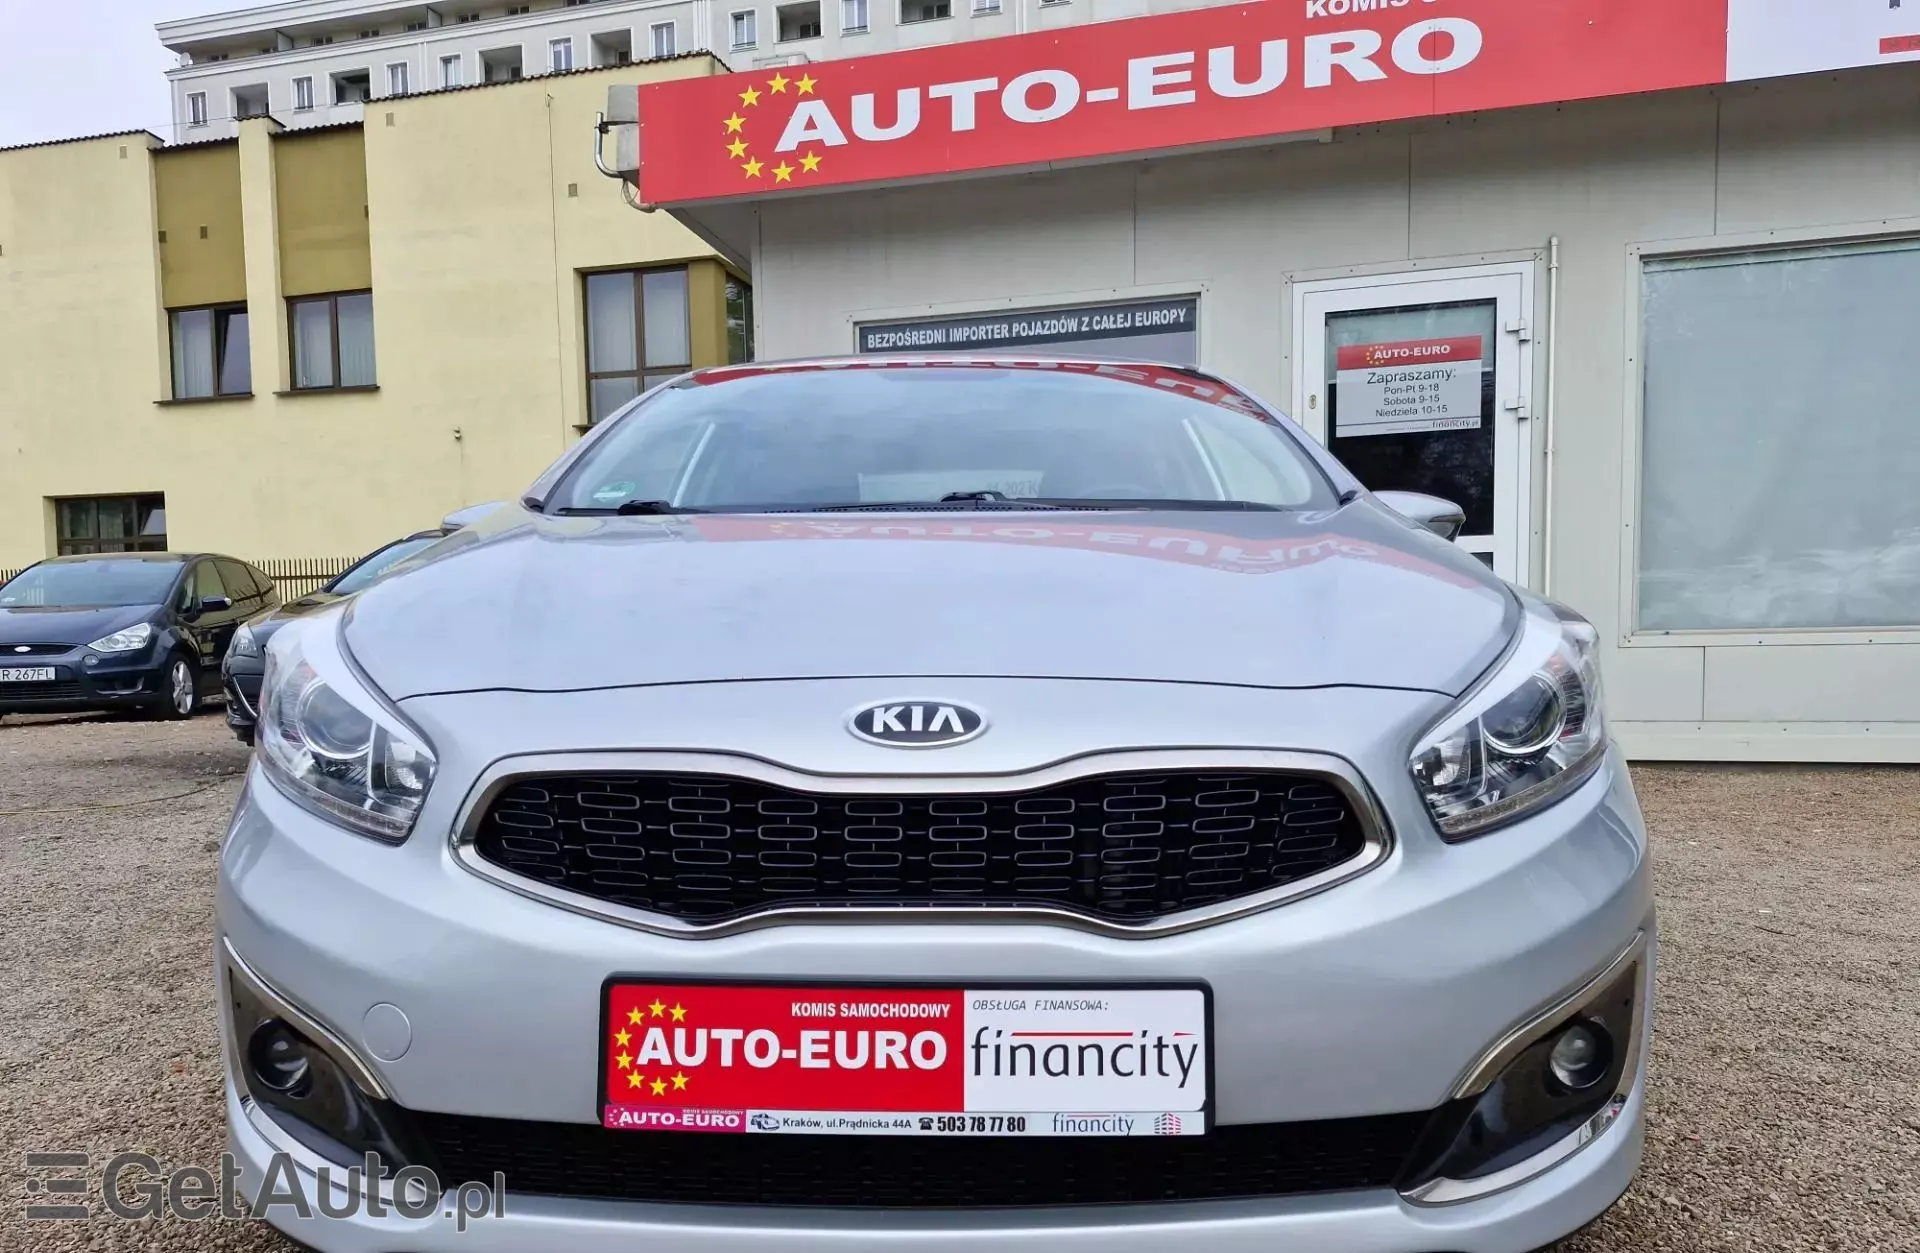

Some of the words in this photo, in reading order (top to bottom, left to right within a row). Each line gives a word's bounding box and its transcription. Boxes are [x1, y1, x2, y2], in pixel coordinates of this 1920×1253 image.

[775, 16, 1483, 153] AUTO-EURO
[867, 328, 946, 349] BEZPOŚREDNI
[950, 324, 1010, 342] IMPORTER
[1012, 315, 1078, 337] POJAZDÓW
[1081, 317, 1089, 331] Z
[1092, 312, 1131, 330] CAŁEJ
[1135, 308, 1187, 327] EUROPY
[1374, 344, 1451, 360] AUTO-EURO
[1367, 368, 1457, 385] Zapraszamy:
[1383, 386, 1416, 395] Pon-Pt
[1418, 383, 1440, 393] 9-18
[1383, 396, 1416, 406] Sobota
[1418, 395, 1440, 404] 9-15
[1376, 407, 1418, 417] Niedziela
[1421, 404, 1448, 415] 10-15
[15, 669, 53, 680] 267FL
[872, 705, 965, 733] KIA
[791, 1002, 836, 1017] KOMIS
[840, 1003, 950, 1018] SAMOCHODOWY
[972, 999, 1027, 1011] OBSŁUGA
[1034, 999, 1109, 1011] FINANSOWA:
[636, 1027, 948, 1070] AUTO-EURO
[971, 1026, 1198, 1088] financity
[619, 1111, 740, 1127] AUTO-EURO
[782, 1117, 824, 1129] Kraków,
[826, 1118, 889, 1130] ul.Prądnicka
[892, 1119, 912, 1129] 44A
[937, 1116, 966, 1132] 503
[969, 1116, 986, 1133] 78
[988, 1116, 1004, 1133] 77
[1007, 1116, 1026, 1133] 80
[1052, 1112, 1134, 1136] financity
